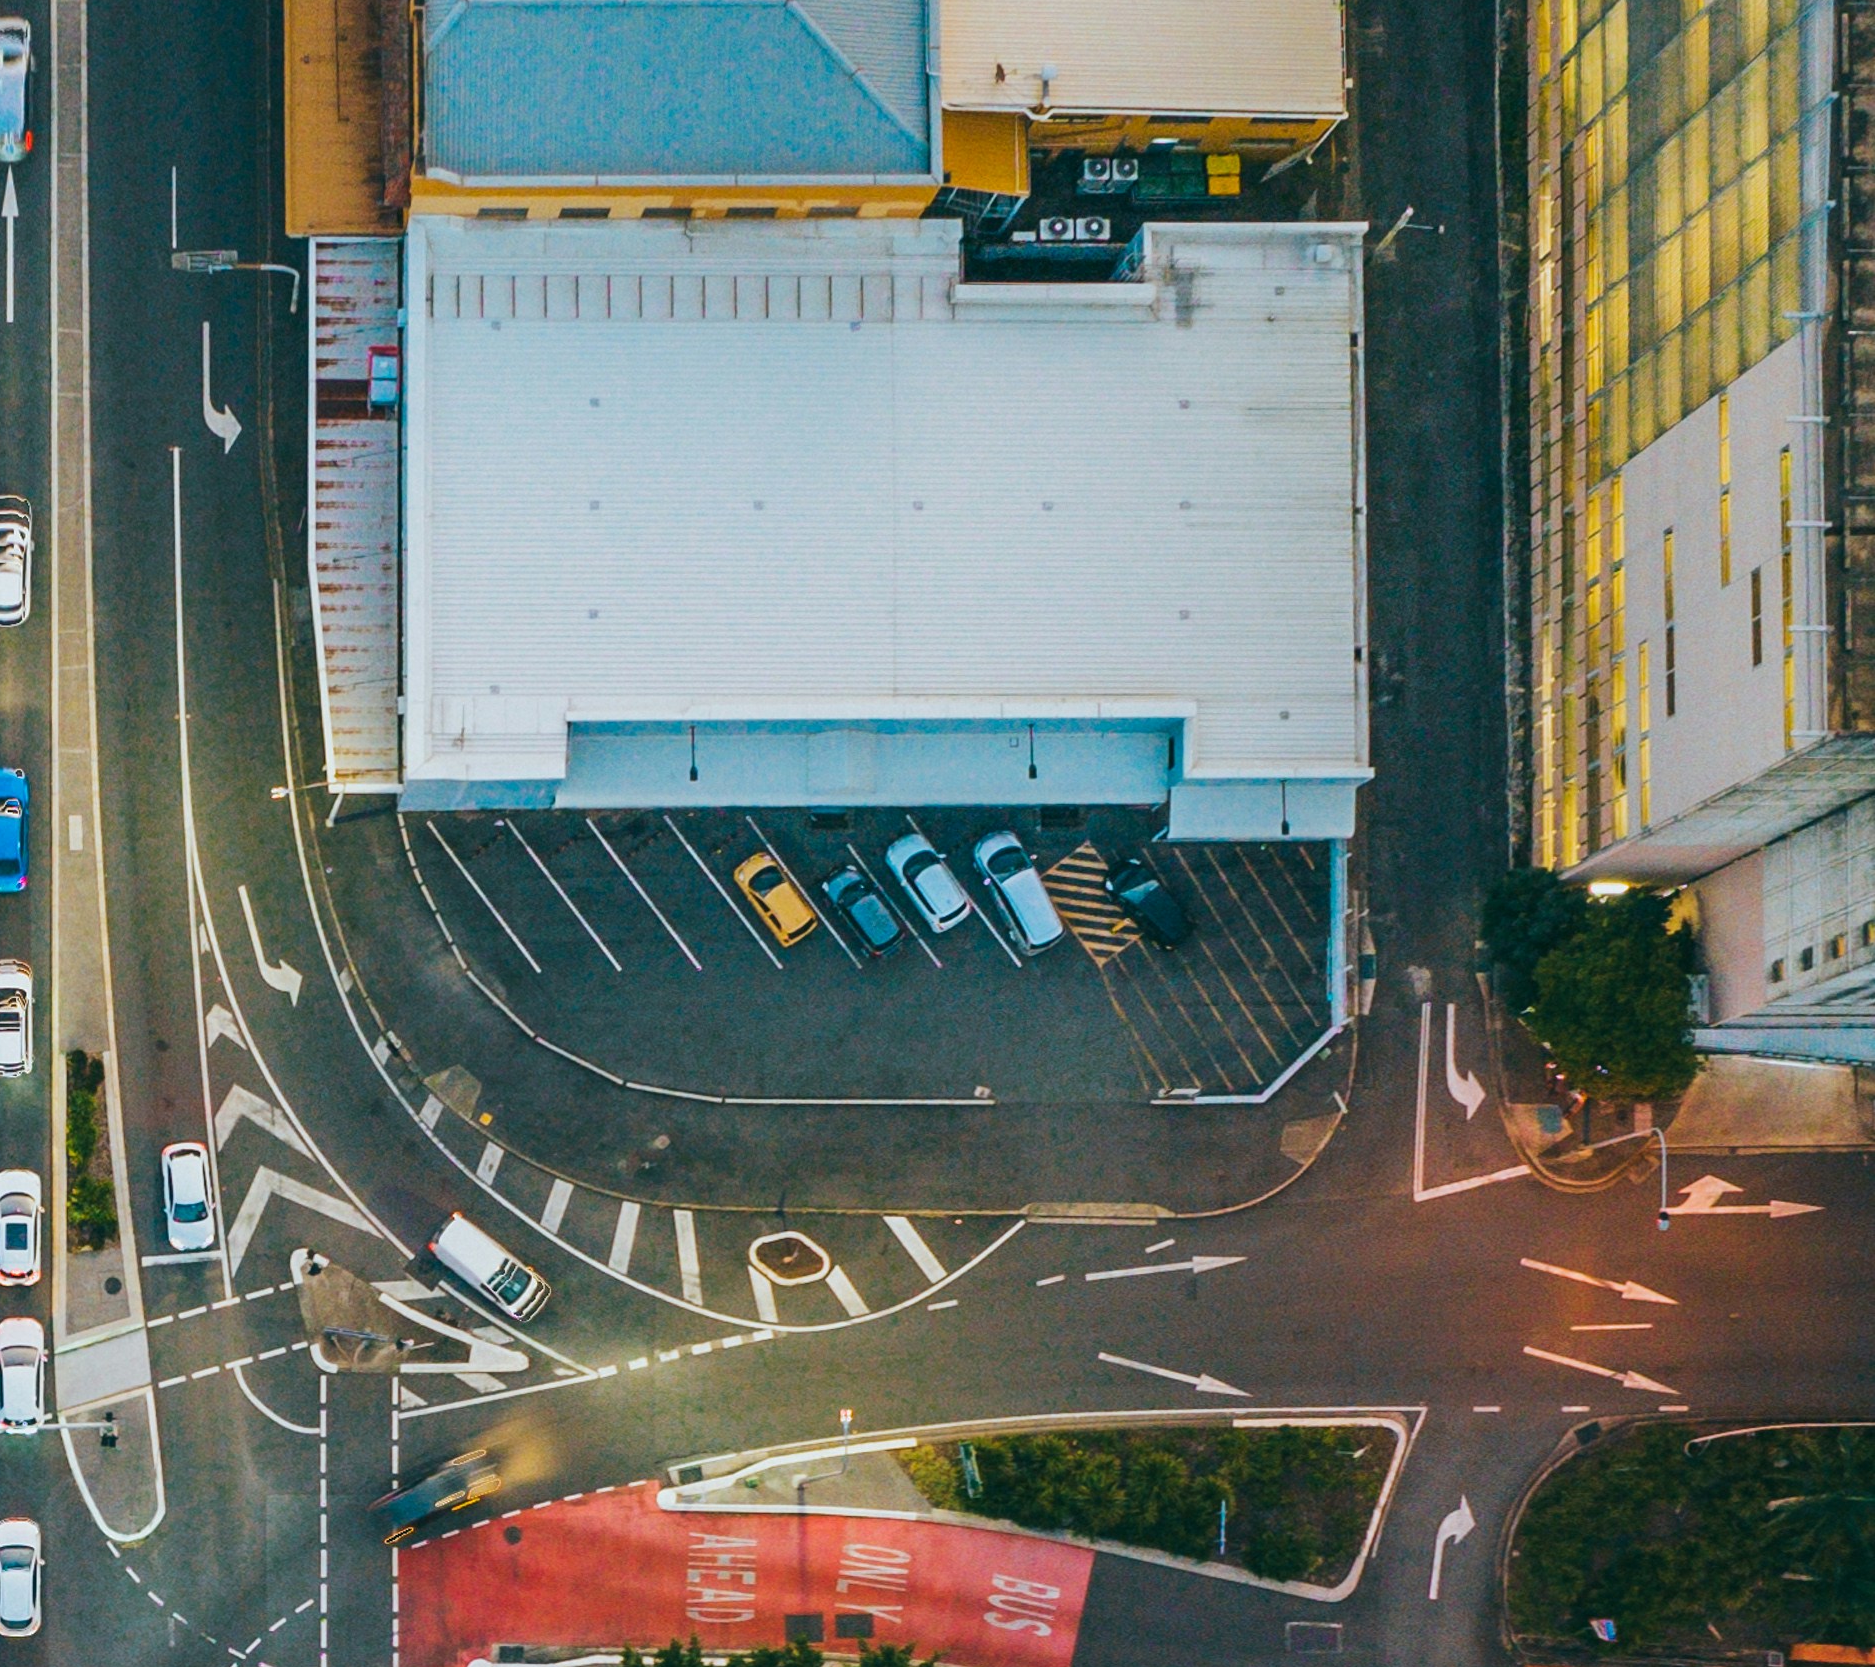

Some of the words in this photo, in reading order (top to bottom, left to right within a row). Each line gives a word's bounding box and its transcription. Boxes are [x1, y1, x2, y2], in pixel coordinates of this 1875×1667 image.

[685, 1532, 758, 1624] AHEAD
[834, 1543, 912, 1624] ONLY
[983, 1573, 1061, 1637] BUS
